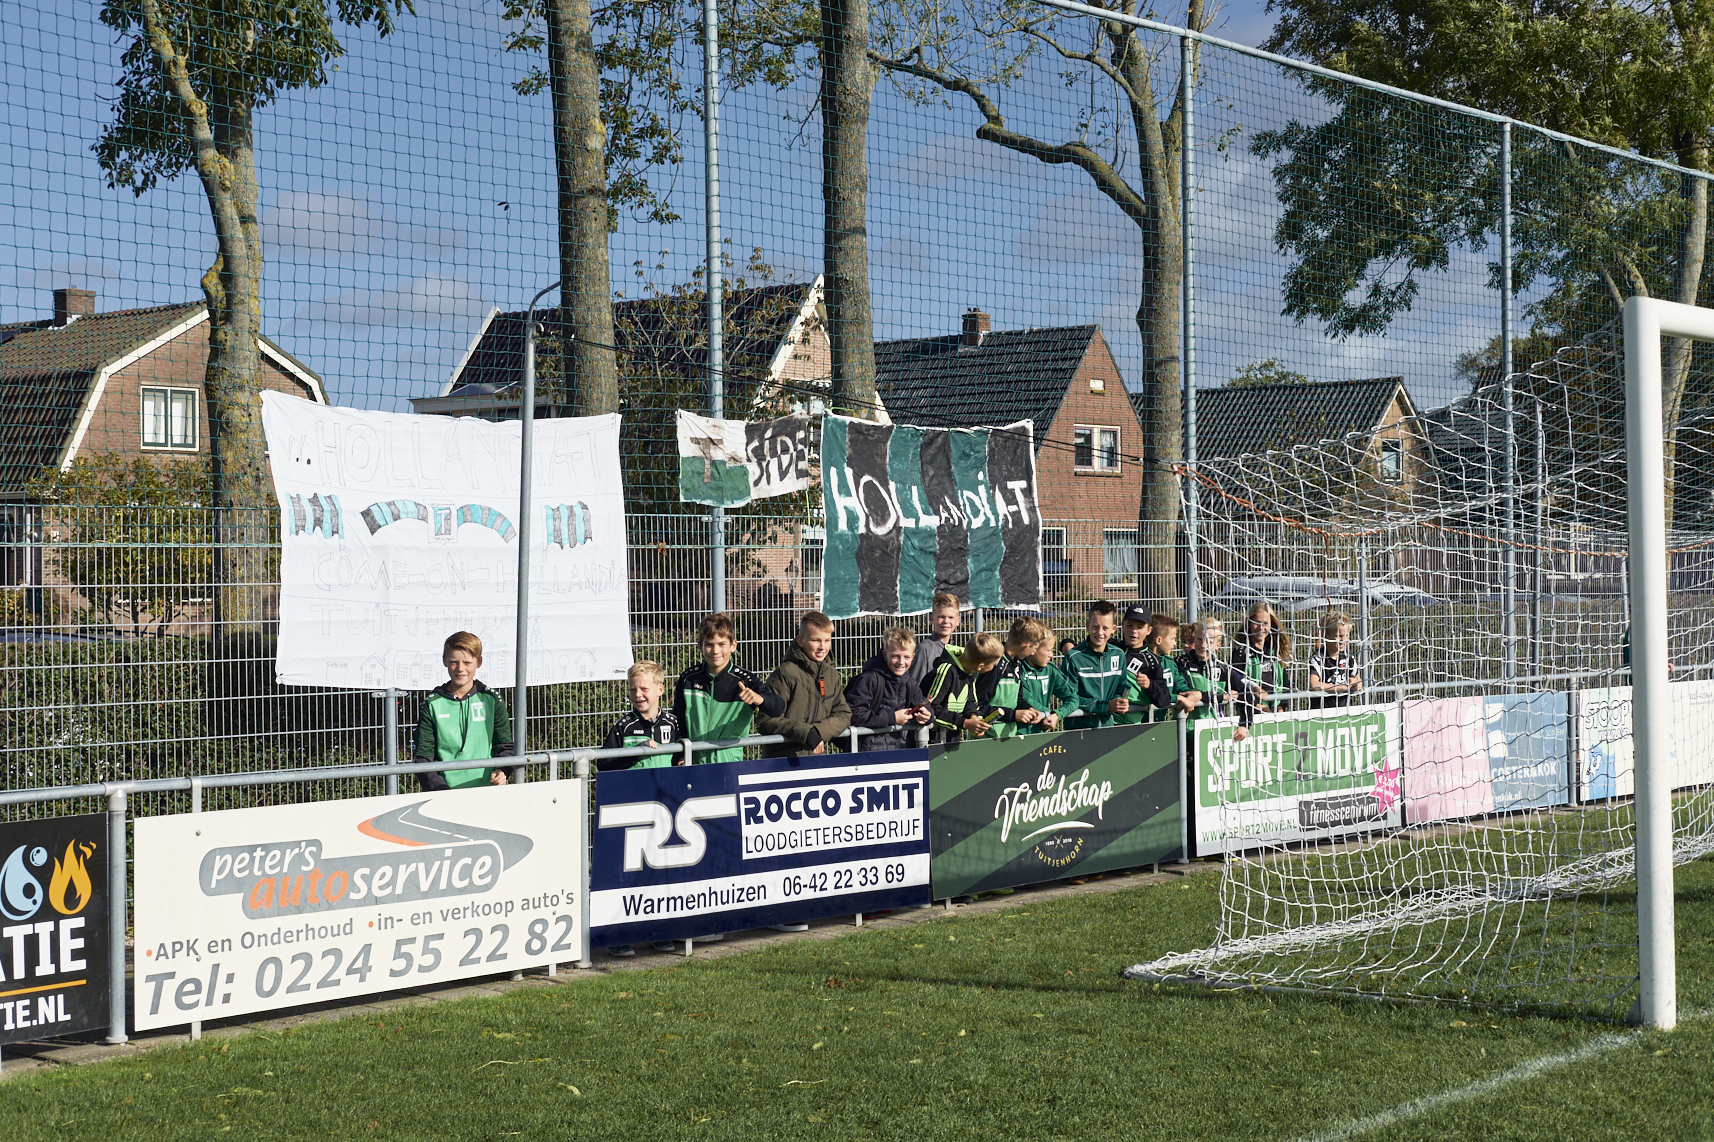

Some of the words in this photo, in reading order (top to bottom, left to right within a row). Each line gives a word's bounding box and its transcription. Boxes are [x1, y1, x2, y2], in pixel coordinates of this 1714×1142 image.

[1585, 700, 1630, 729] STOOP
[1043, 745, 1063, 756] CAFE
[1207, 732, 1288, 794] SPORT
[1294, 731, 1309, 781] 2
[1316, 724, 1380, 780] MOVE
[1036, 759, 1057, 792] de
[744, 788, 842, 826] ROCCO
[849, 783, 920, 815] SMIT
[994, 768, 1114, 843] Vriendschap
[1309, 802, 1378, 825] fitnesscentrum
[599, 794, 738, 872] RS
[745, 818, 920, 854] LOODGIETERSBEDRIJF
[1034, 837, 1084, 867] TUITJENHORN
[622, 883, 767, 917] Warmenhuizen
[783, 871, 828, 897] 06-42
[833, 869, 853, 890] 22
[858, 866, 879, 887] 33
[885, 863, 905, 884] 69
[154, 938, 200, 961] APK
[207, 938, 232, 954] en
[240, 918, 354, 950] Onderhoud
[377, 913, 404, 931] in-
[410, 911, 433, 926] en
[440, 901, 514, 922] verkoop
[521, 889, 575, 911] auto's
[0, 916, 87, 982] TIE
[144, 963, 235, 1015] Tel:
[255, 943, 373, 998] 0224
[388, 932, 445, 978] 55
[458, 924, 510, 967] 22
[524, 914, 574, 956] 82
[0, 994, 71, 1031] IE.NL
